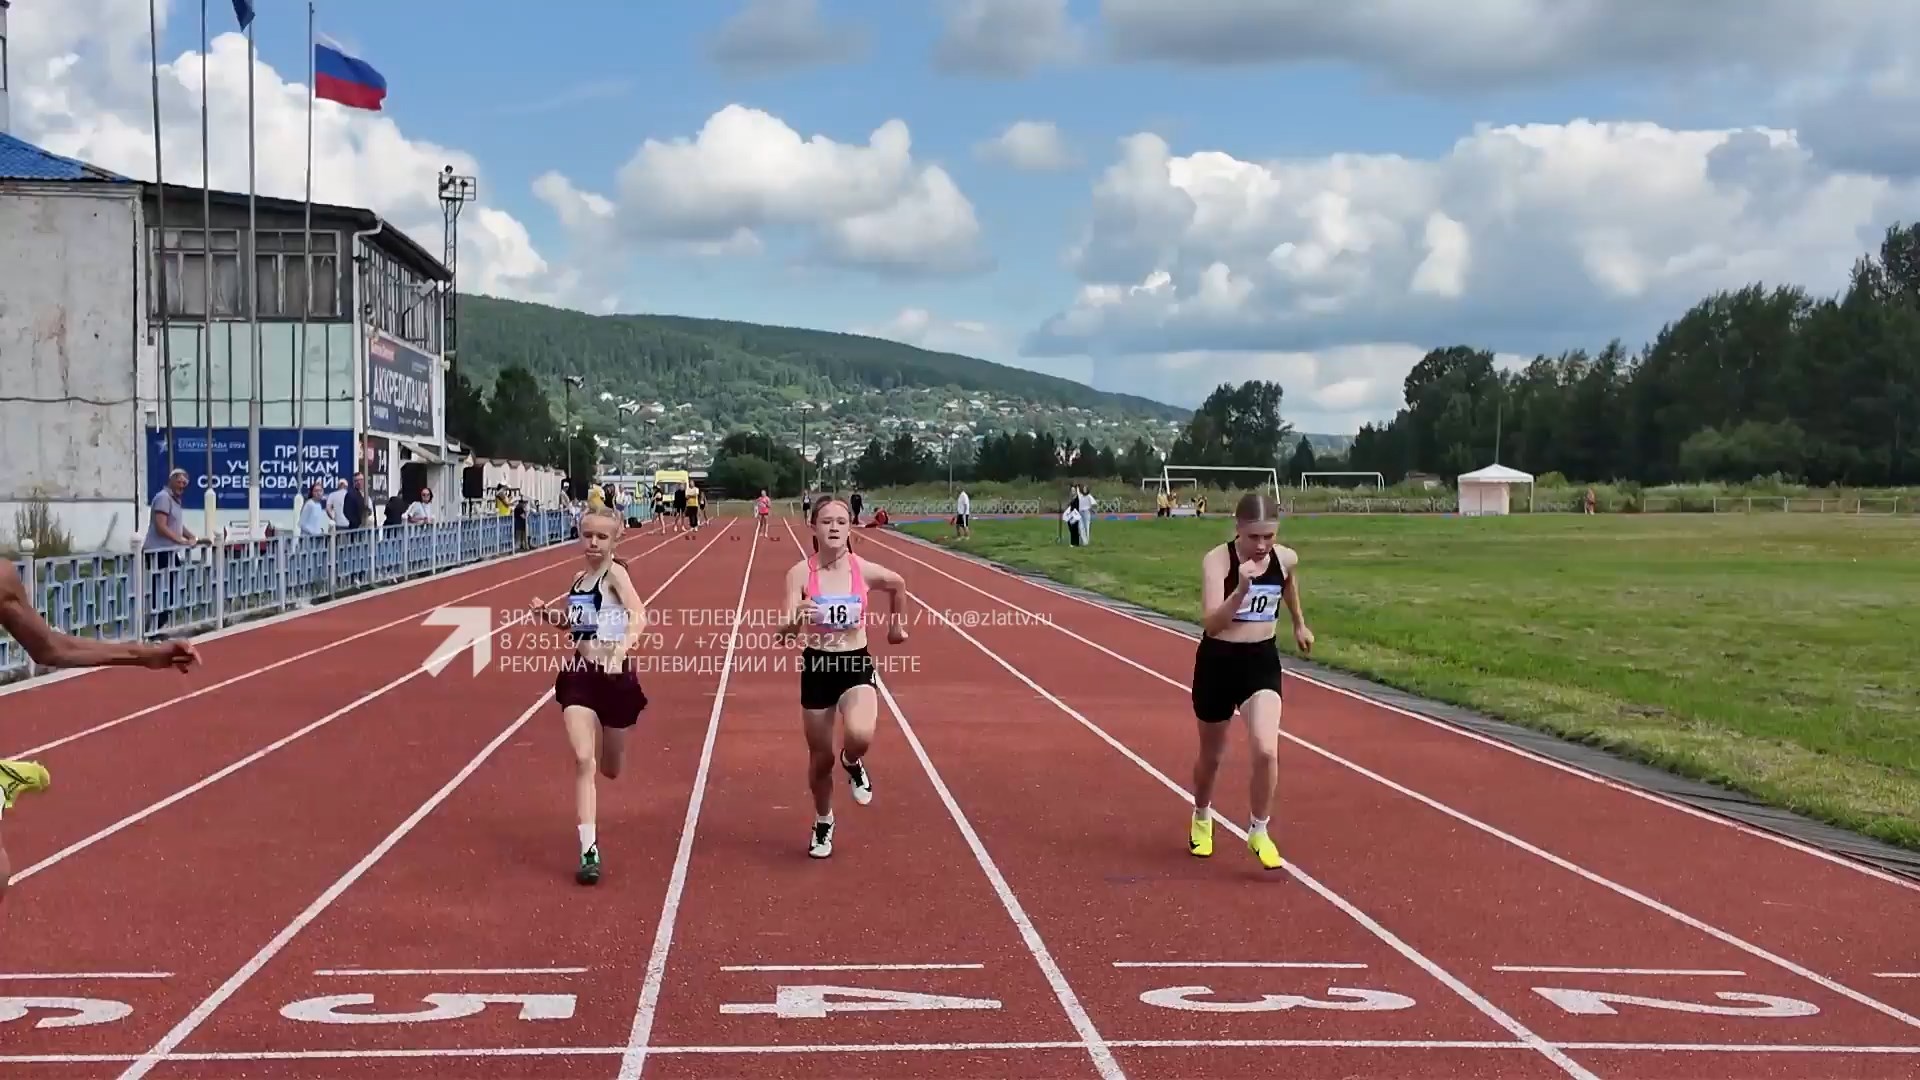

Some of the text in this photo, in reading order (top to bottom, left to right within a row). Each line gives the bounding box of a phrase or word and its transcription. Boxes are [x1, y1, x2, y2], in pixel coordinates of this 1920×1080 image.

[373, 365, 429, 418] АККРЕДИТАЦИЯ
[275, 445, 339, 459] ПРИВЕТ
[227, 460, 339, 474] УЧСТНИКАМ
[1250, 595, 1267, 613] 10
[829, 605, 847, 624] 16
[280, 993, 577, 1024] 5
[720, 986, 1002, 1018] 4
[1140, 985, 1416, 1012] 3
[1532, 987, 1820, 1017] 2
